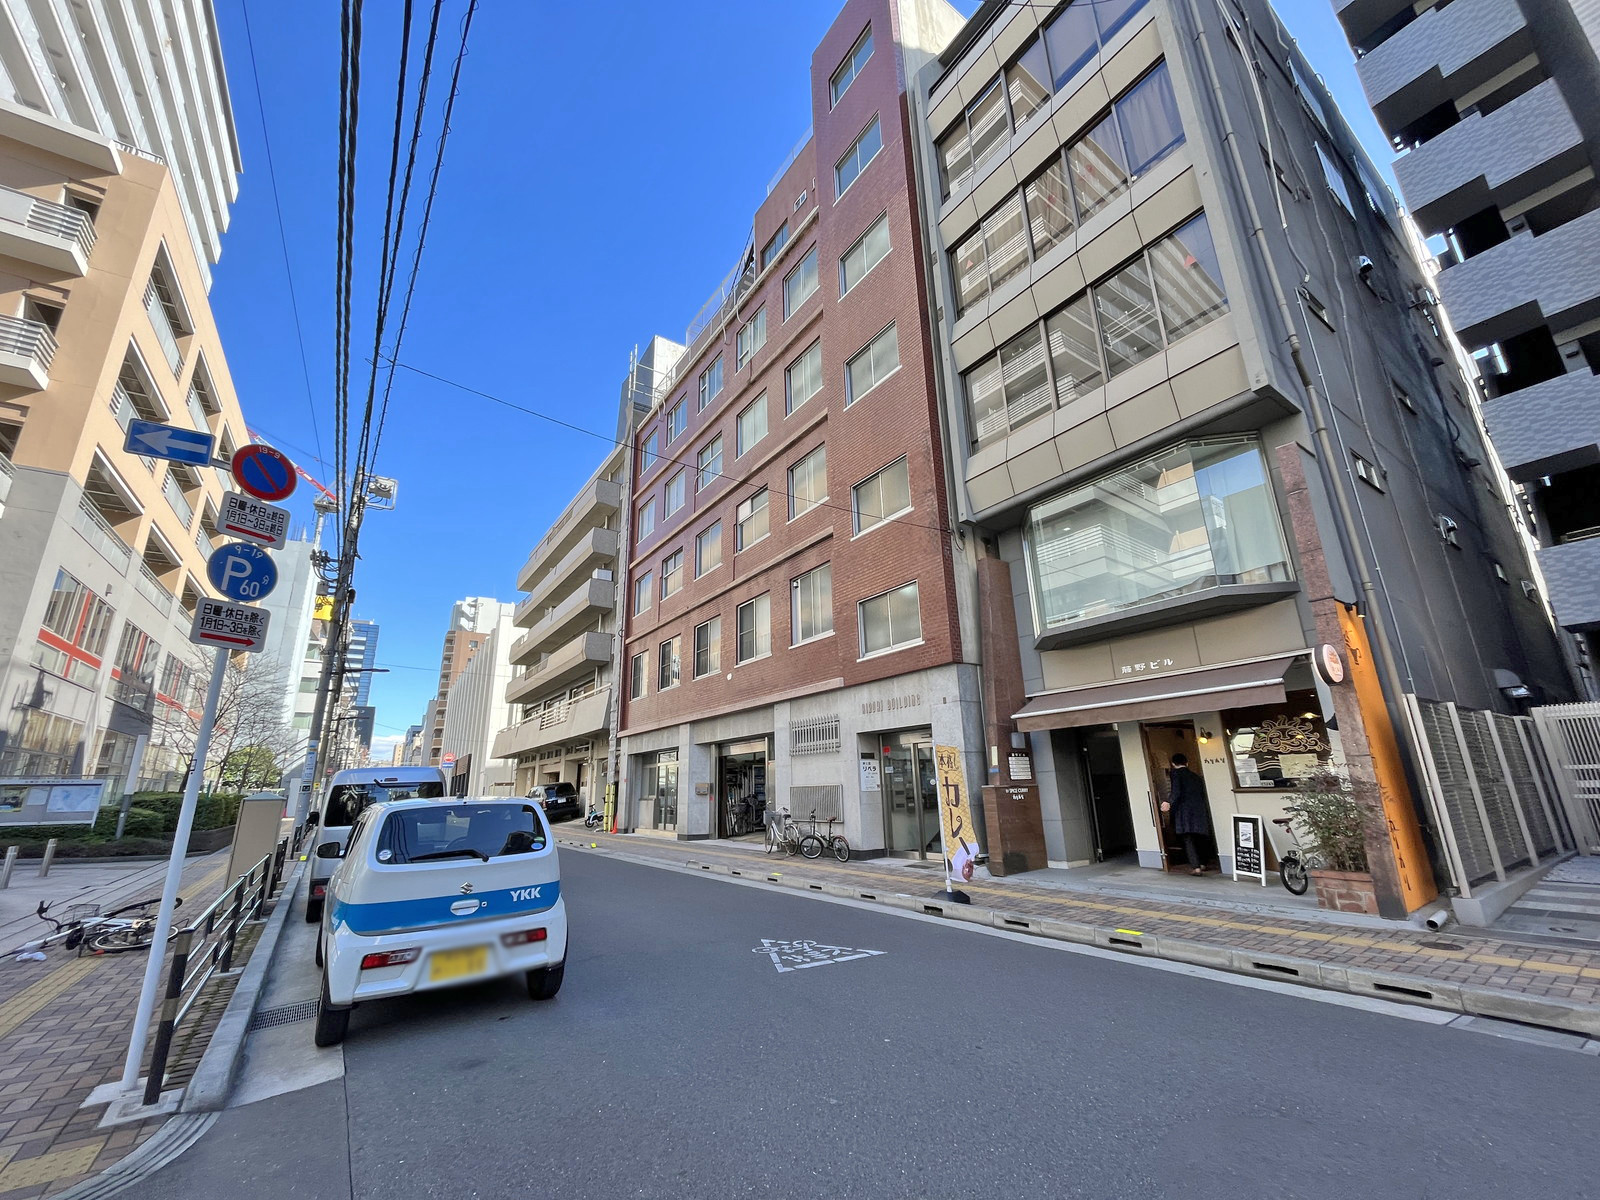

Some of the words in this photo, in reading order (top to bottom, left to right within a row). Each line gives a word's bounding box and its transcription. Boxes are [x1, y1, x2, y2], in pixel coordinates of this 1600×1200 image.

[234, 545, 264, 559] 9-19
[221, 555, 252, 591] P
[942, 776, 971, 855] カレー
[510, 887, 541, 902] YKK
